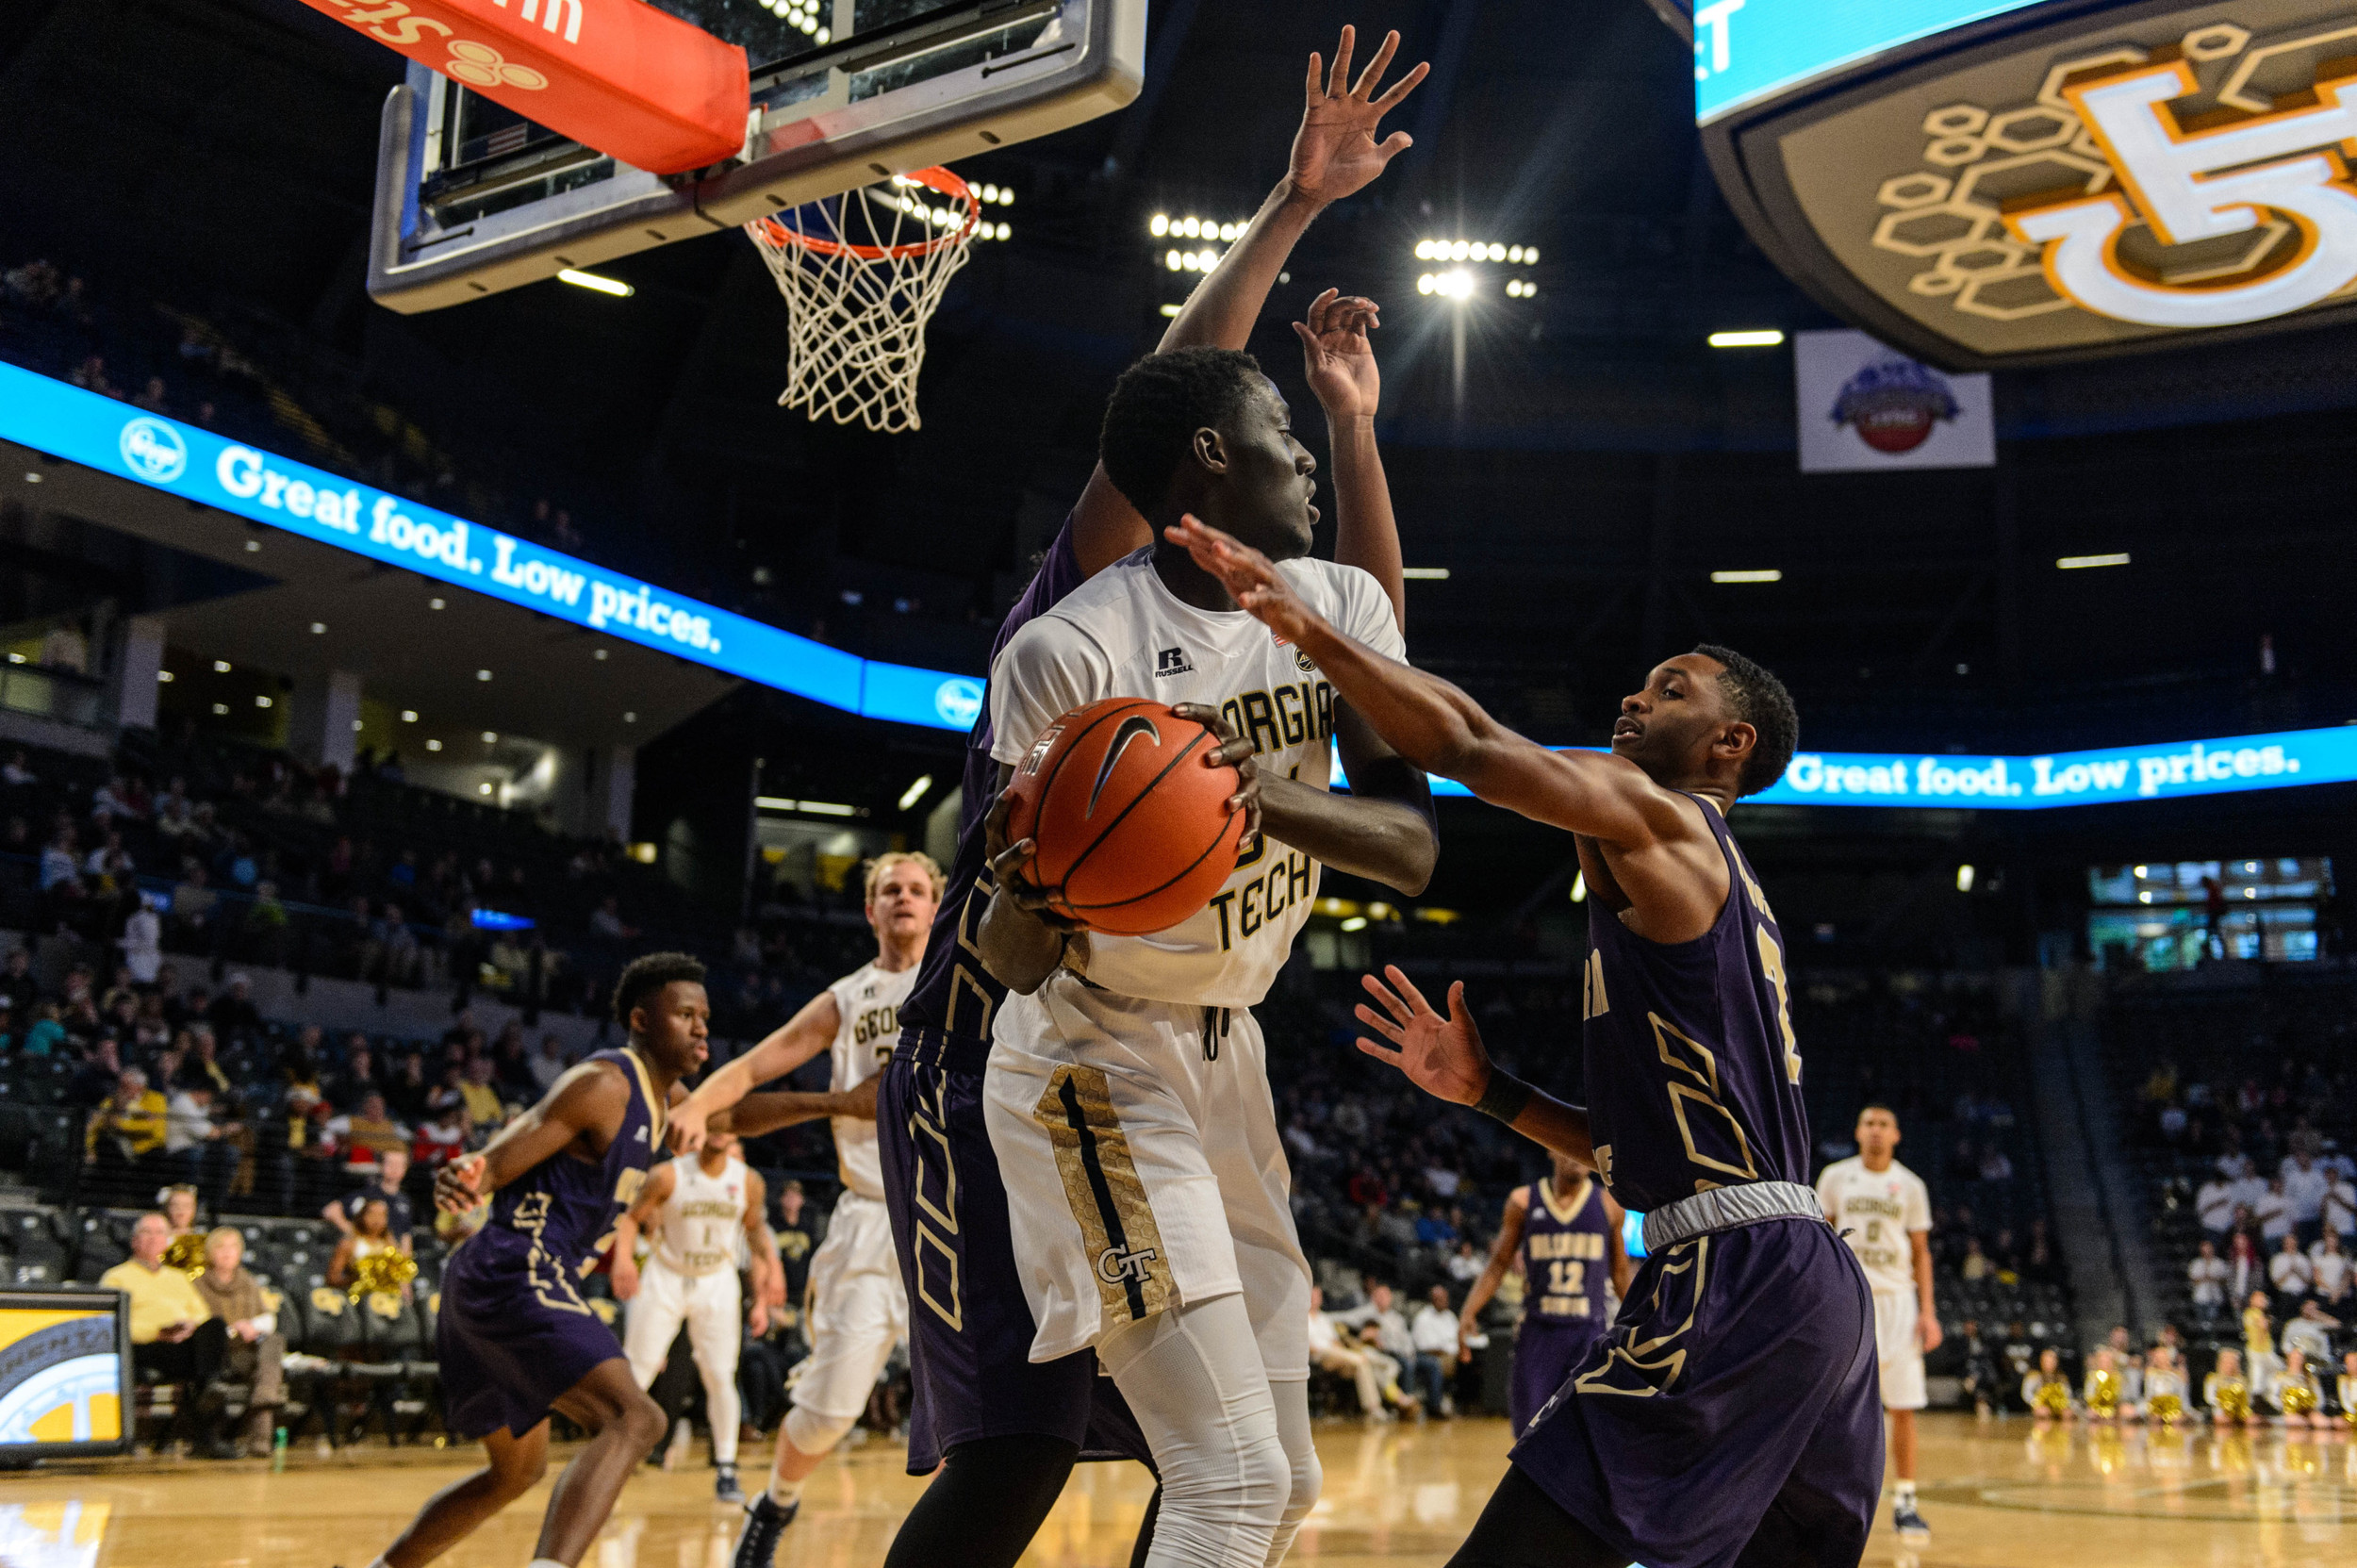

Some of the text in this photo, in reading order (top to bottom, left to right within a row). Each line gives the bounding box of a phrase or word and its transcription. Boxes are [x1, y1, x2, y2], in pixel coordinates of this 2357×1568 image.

[216, 444, 722, 653] Great food. Low prices.
[1155, 664, 1194, 678] RUSSELL
[1220, 679, 1333, 755] ORGIA
[1788, 743, 2300, 797] Great food. Low prices.
[1208, 850, 1311, 953] TECH
[1096, 1242, 1157, 1284] GT
[1546, 1260, 1584, 1295] 12
